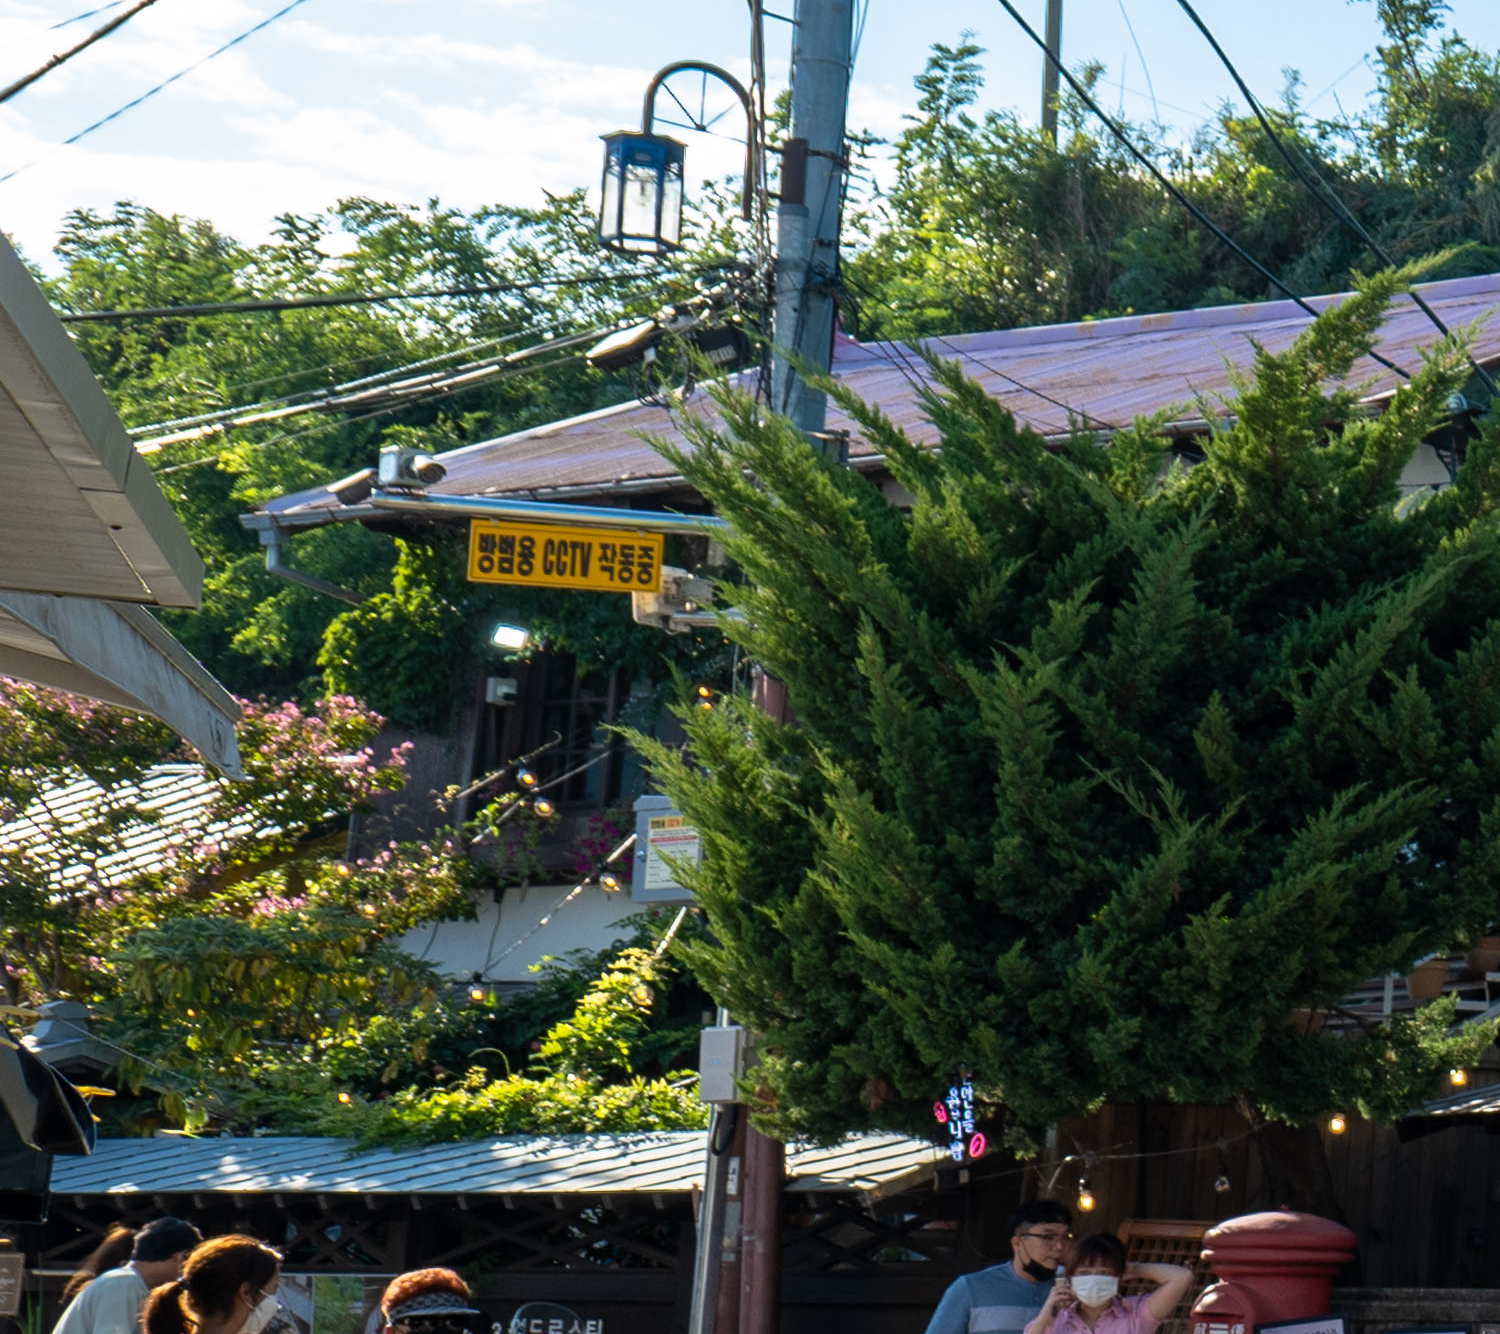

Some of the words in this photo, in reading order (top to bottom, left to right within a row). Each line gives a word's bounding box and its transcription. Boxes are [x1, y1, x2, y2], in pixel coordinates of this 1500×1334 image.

[478, 533, 536, 577] 방범용
[542, 538, 593, 578] CCTV
[598, 542, 654, 585] 작동중
